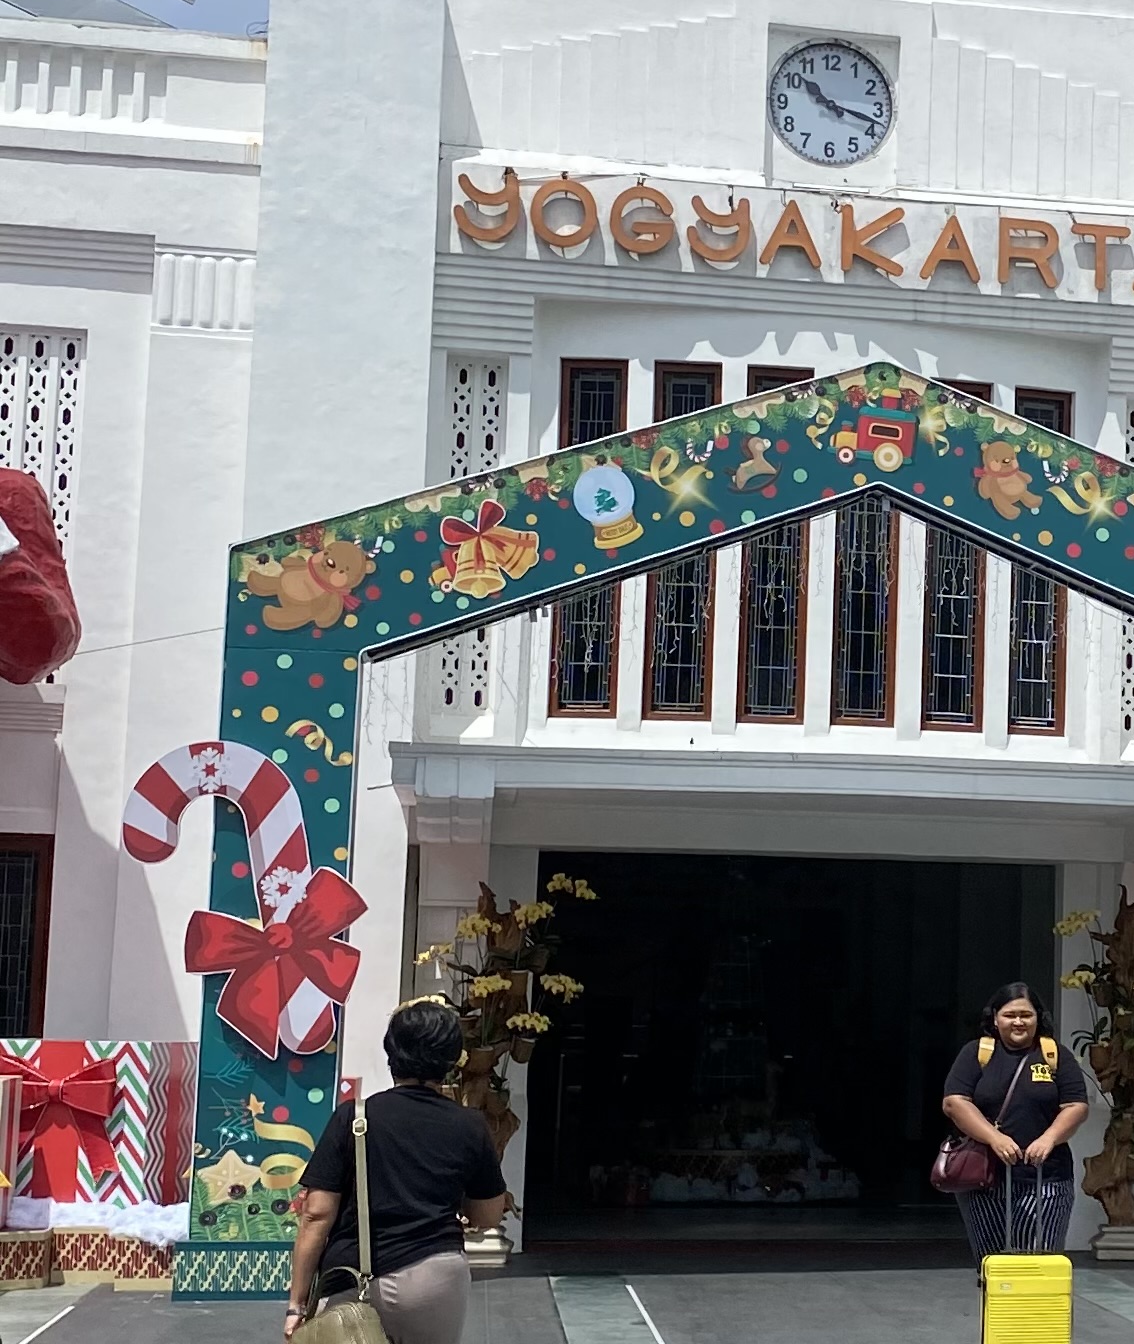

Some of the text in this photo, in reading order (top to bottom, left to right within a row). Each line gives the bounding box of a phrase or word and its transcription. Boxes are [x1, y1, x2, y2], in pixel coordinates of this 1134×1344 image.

[799, 57, 814, 74] 11
[821, 54, 841, 71] 12
[850, 62, 858, 78] 1
[783, 72, 801, 89] 10
[865, 79, 876, 96] 2
[777, 93, 788, 110] 9
[872, 102, 883, 118] 3
[784, 116, 794, 132] 8
[865, 123, 876, 139] 4
[800, 132, 811, 148] 7
[848, 137, 858, 153] 5
[824, 141, 835, 158] 6
